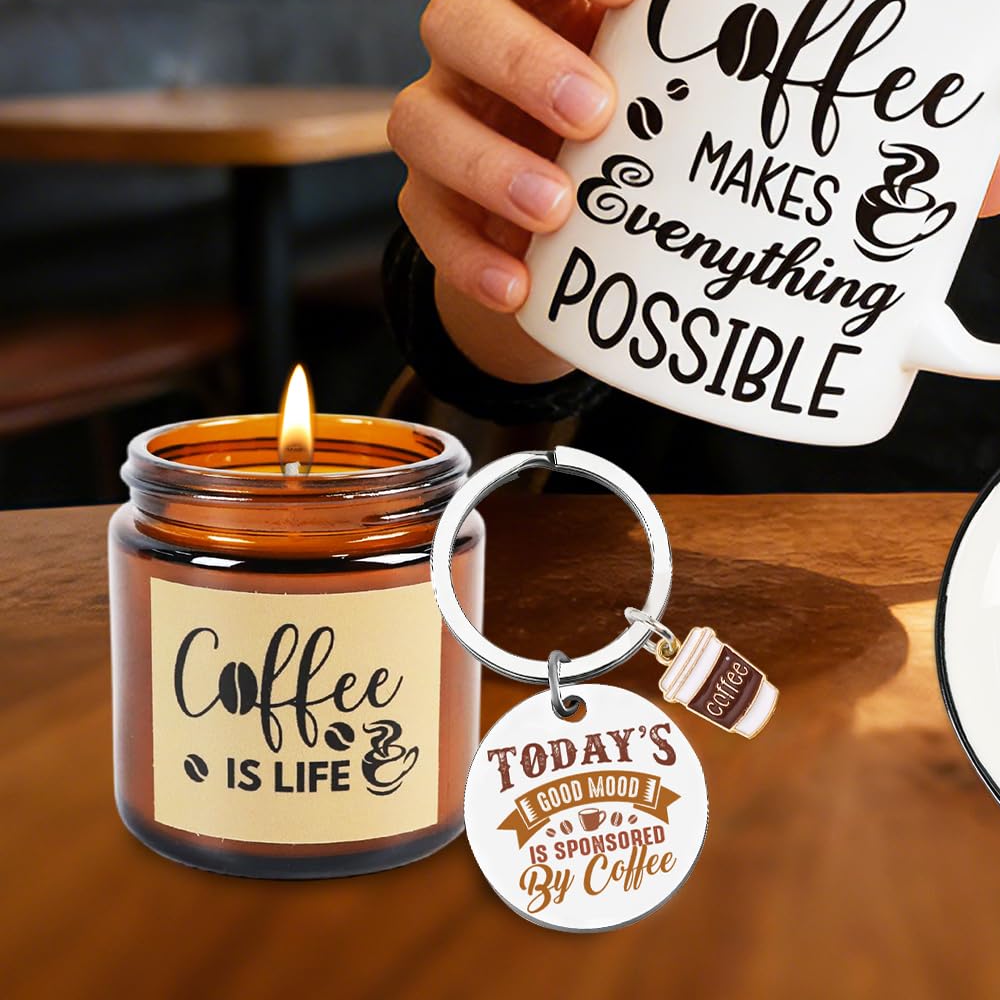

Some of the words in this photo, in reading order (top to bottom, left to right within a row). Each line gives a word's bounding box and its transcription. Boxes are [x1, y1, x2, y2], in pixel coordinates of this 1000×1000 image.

[689, 131, 840, 226] MAKES
[547, 246, 862, 418] POSSIBLE
[174, 623, 403, 753] Coffee
[706, 660, 750, 718] coffee
[226, 757, 262, 792] IS
[274, 759, 351, 793] LIFE
[487, 723, 677, 793] TODAY'S
[536, 779, 582, 812] GOOD
[588, 776, 640, 800] MOOD
[519, 863, 575, 914] By
[583, 844, 677, 896] Coffee
[528, 845, 549, 864] IS
[555, 824, 666, 862] SPONSORED
